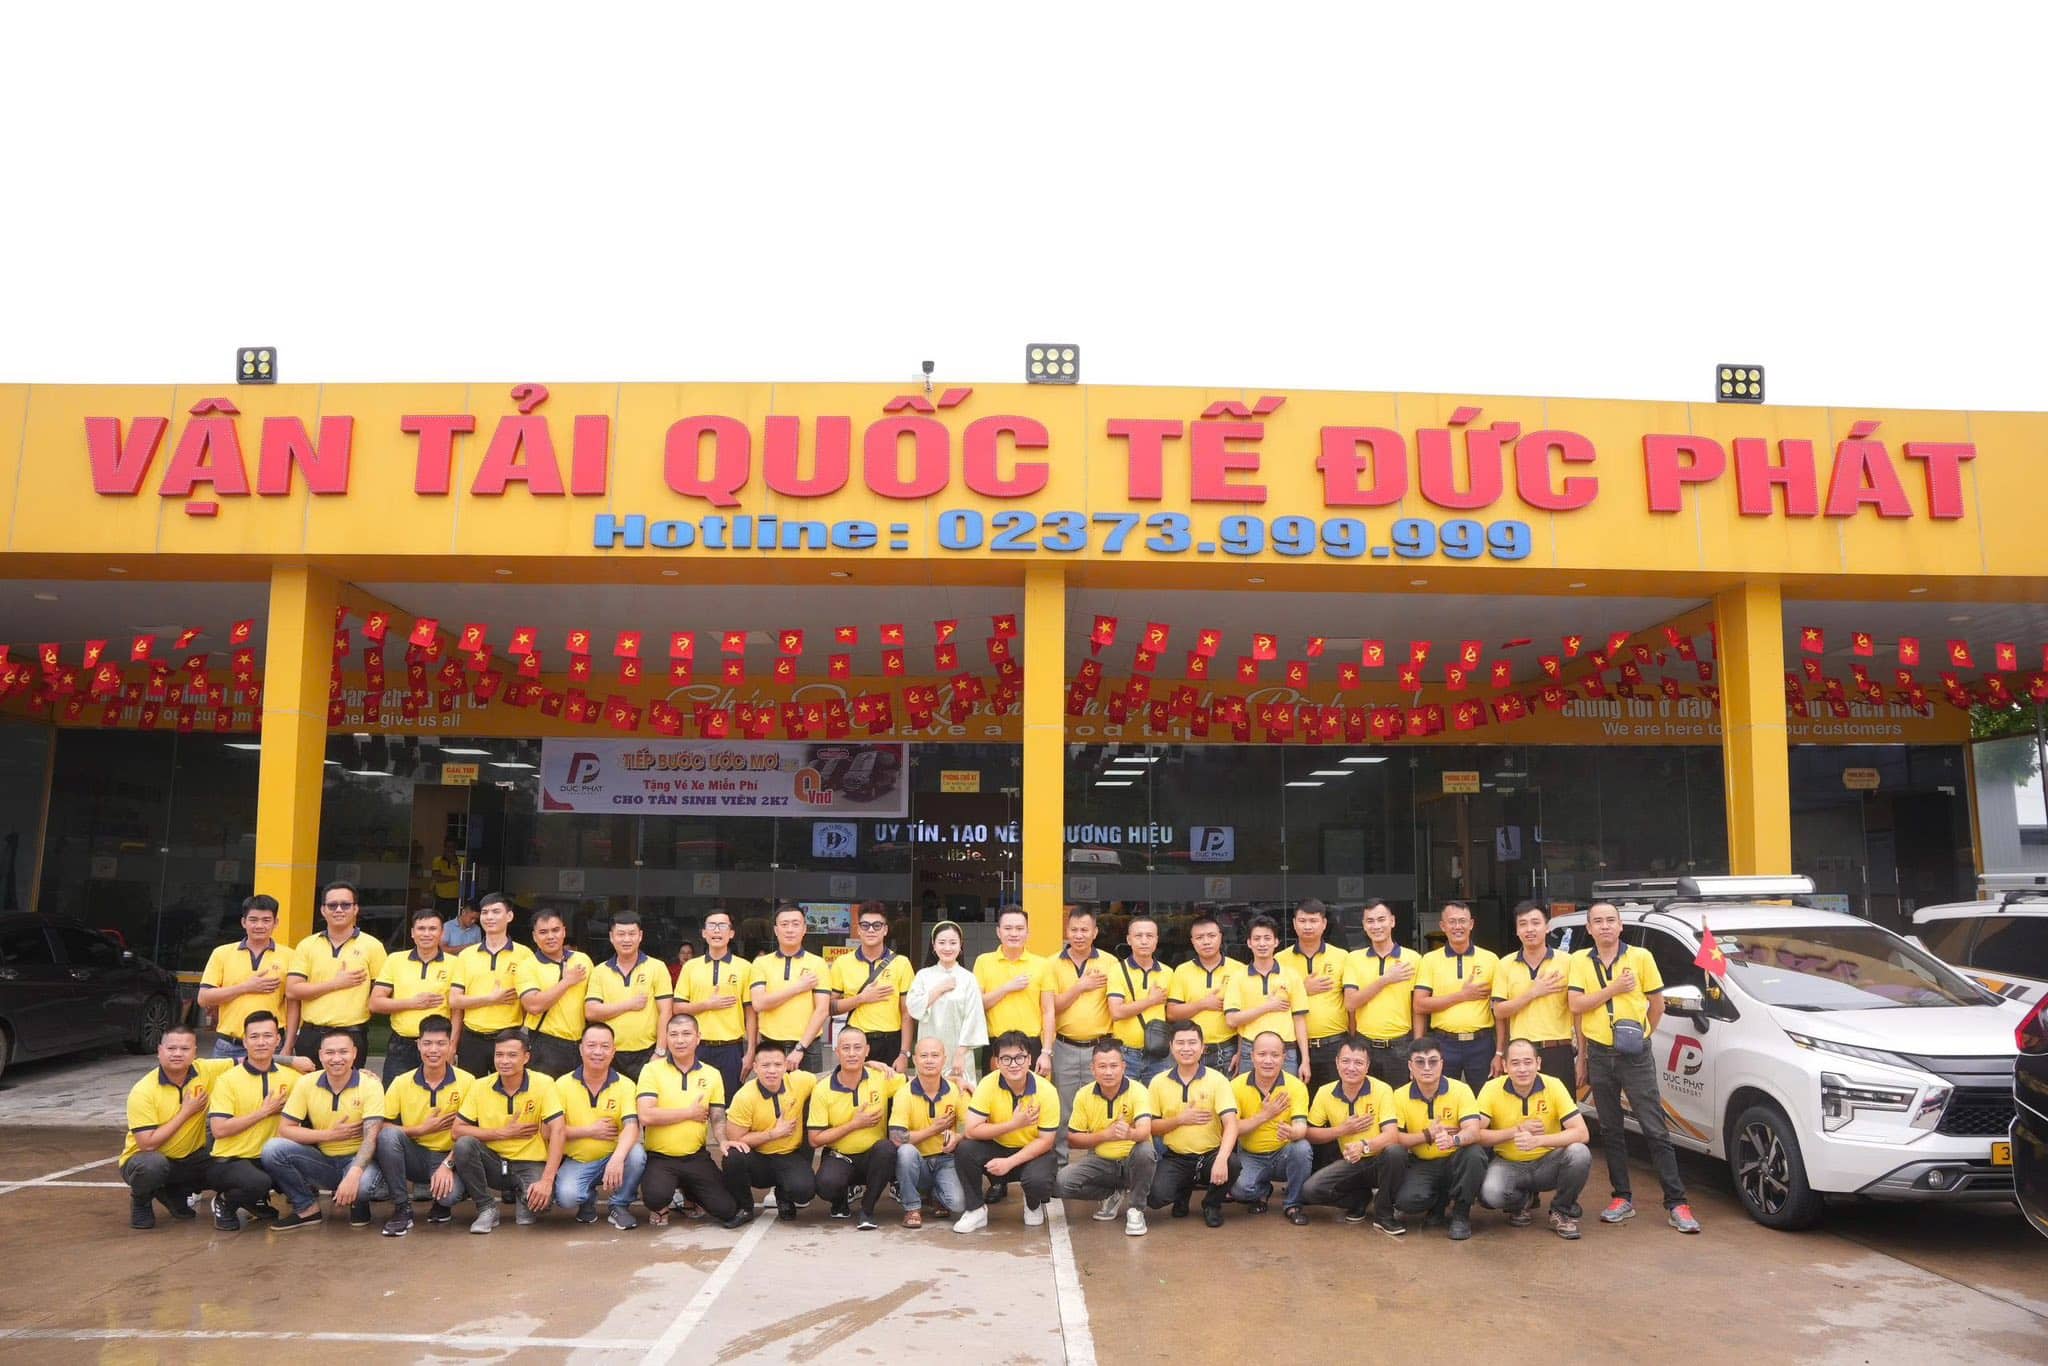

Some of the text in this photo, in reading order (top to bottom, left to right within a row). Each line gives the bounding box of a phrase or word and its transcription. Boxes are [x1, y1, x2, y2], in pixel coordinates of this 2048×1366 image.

[84, 383, 1978, 520] VẬN TẢI QUỐC TẾ ĐỨC PHÁT
[593, 508, 1532, 560] Hotline: 02373.999.999
[418, 716, 437, 727] us
[442, 712, 461, 727] all
[1602, 721, 1629, 736] We
[1634, 723, 1661, 736] are
[1664, 722, 1704, 736] here
[1812, 722, 1903, 736] customers
[622, 747, 656, 771] TIẾP
[643, 777, 758, 793] Tặng Vé Xe Miễn Phí
[612, 793, 789, 806] CHO TÂN SINH VIÊN 2K7
[874, 823, 899, 841] UY
[950, 824, 988, 848] TẠO
[994, 820, 1021, 843] NÊ
[1063, 823, 1123, 844] ƯƠNG
[1128, 821, 1174, 848] HIỆU
